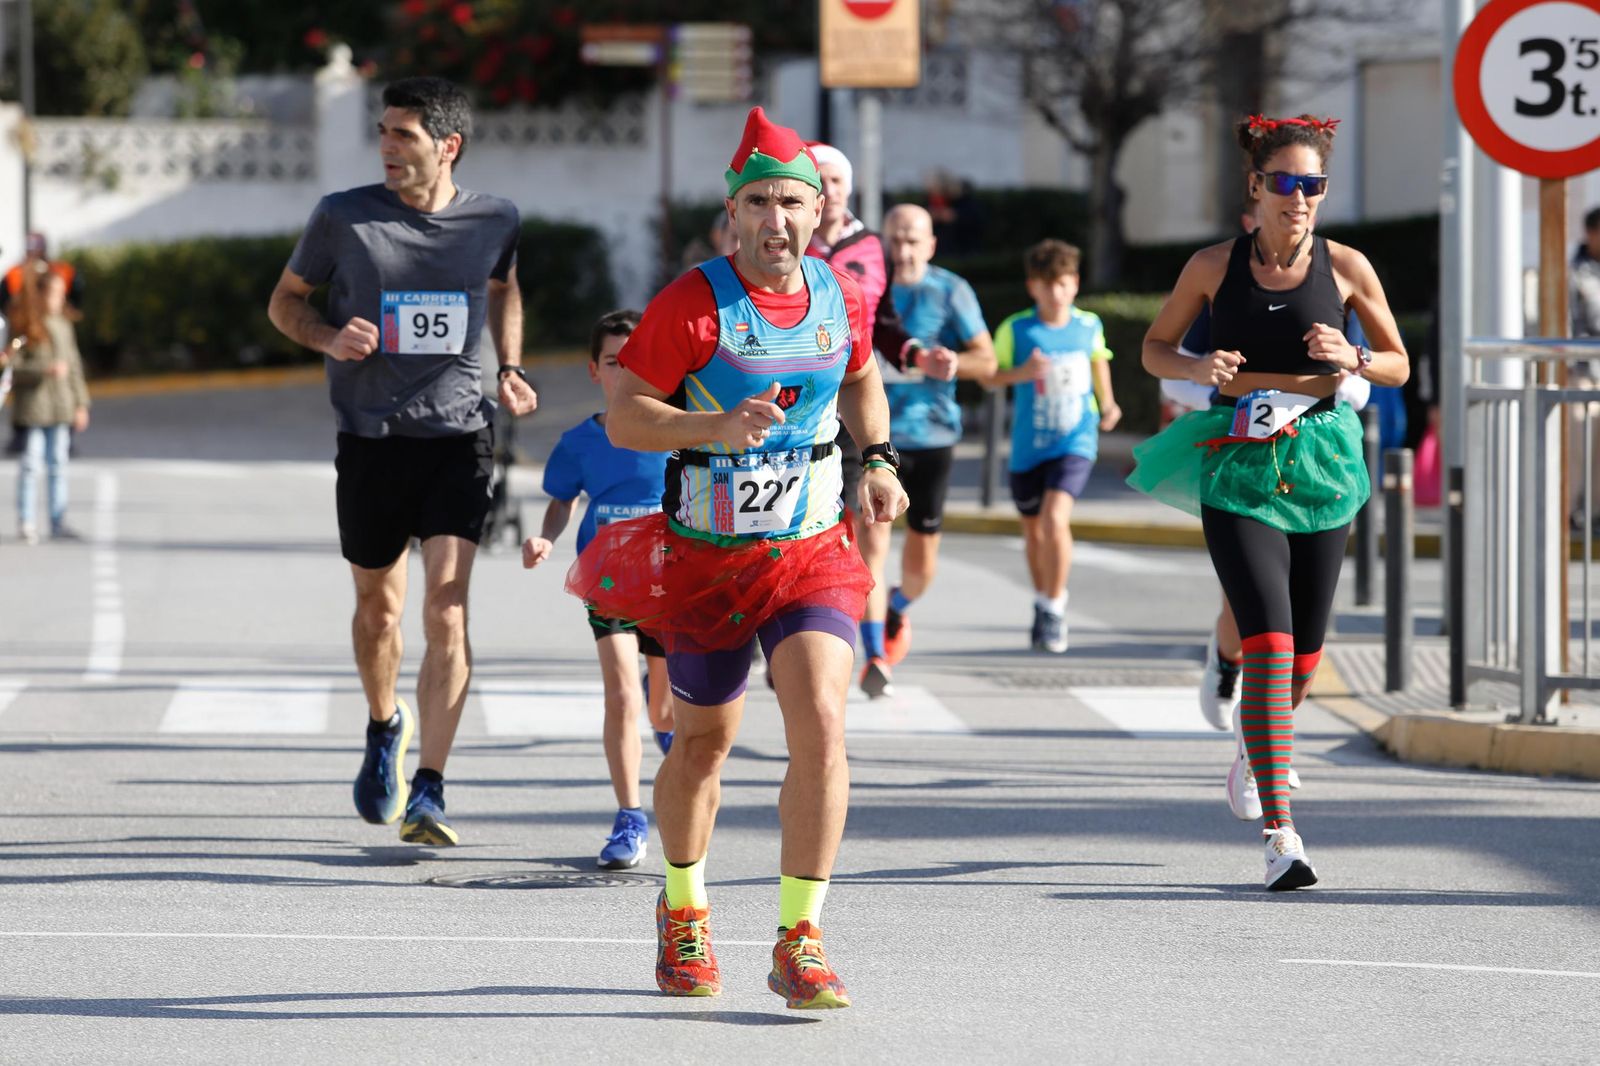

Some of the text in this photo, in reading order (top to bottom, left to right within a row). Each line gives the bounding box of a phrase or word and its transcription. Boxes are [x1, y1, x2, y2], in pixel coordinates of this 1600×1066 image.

[403, 294, 465, 303] CARRERA
[412, 312, 449, 338] 95
[713, 472, 729, 484] SAN
[714, 484, 729, 500] SIL
[714, 500, 733, 517] VES
[714, 517, 734, 532] TRE
